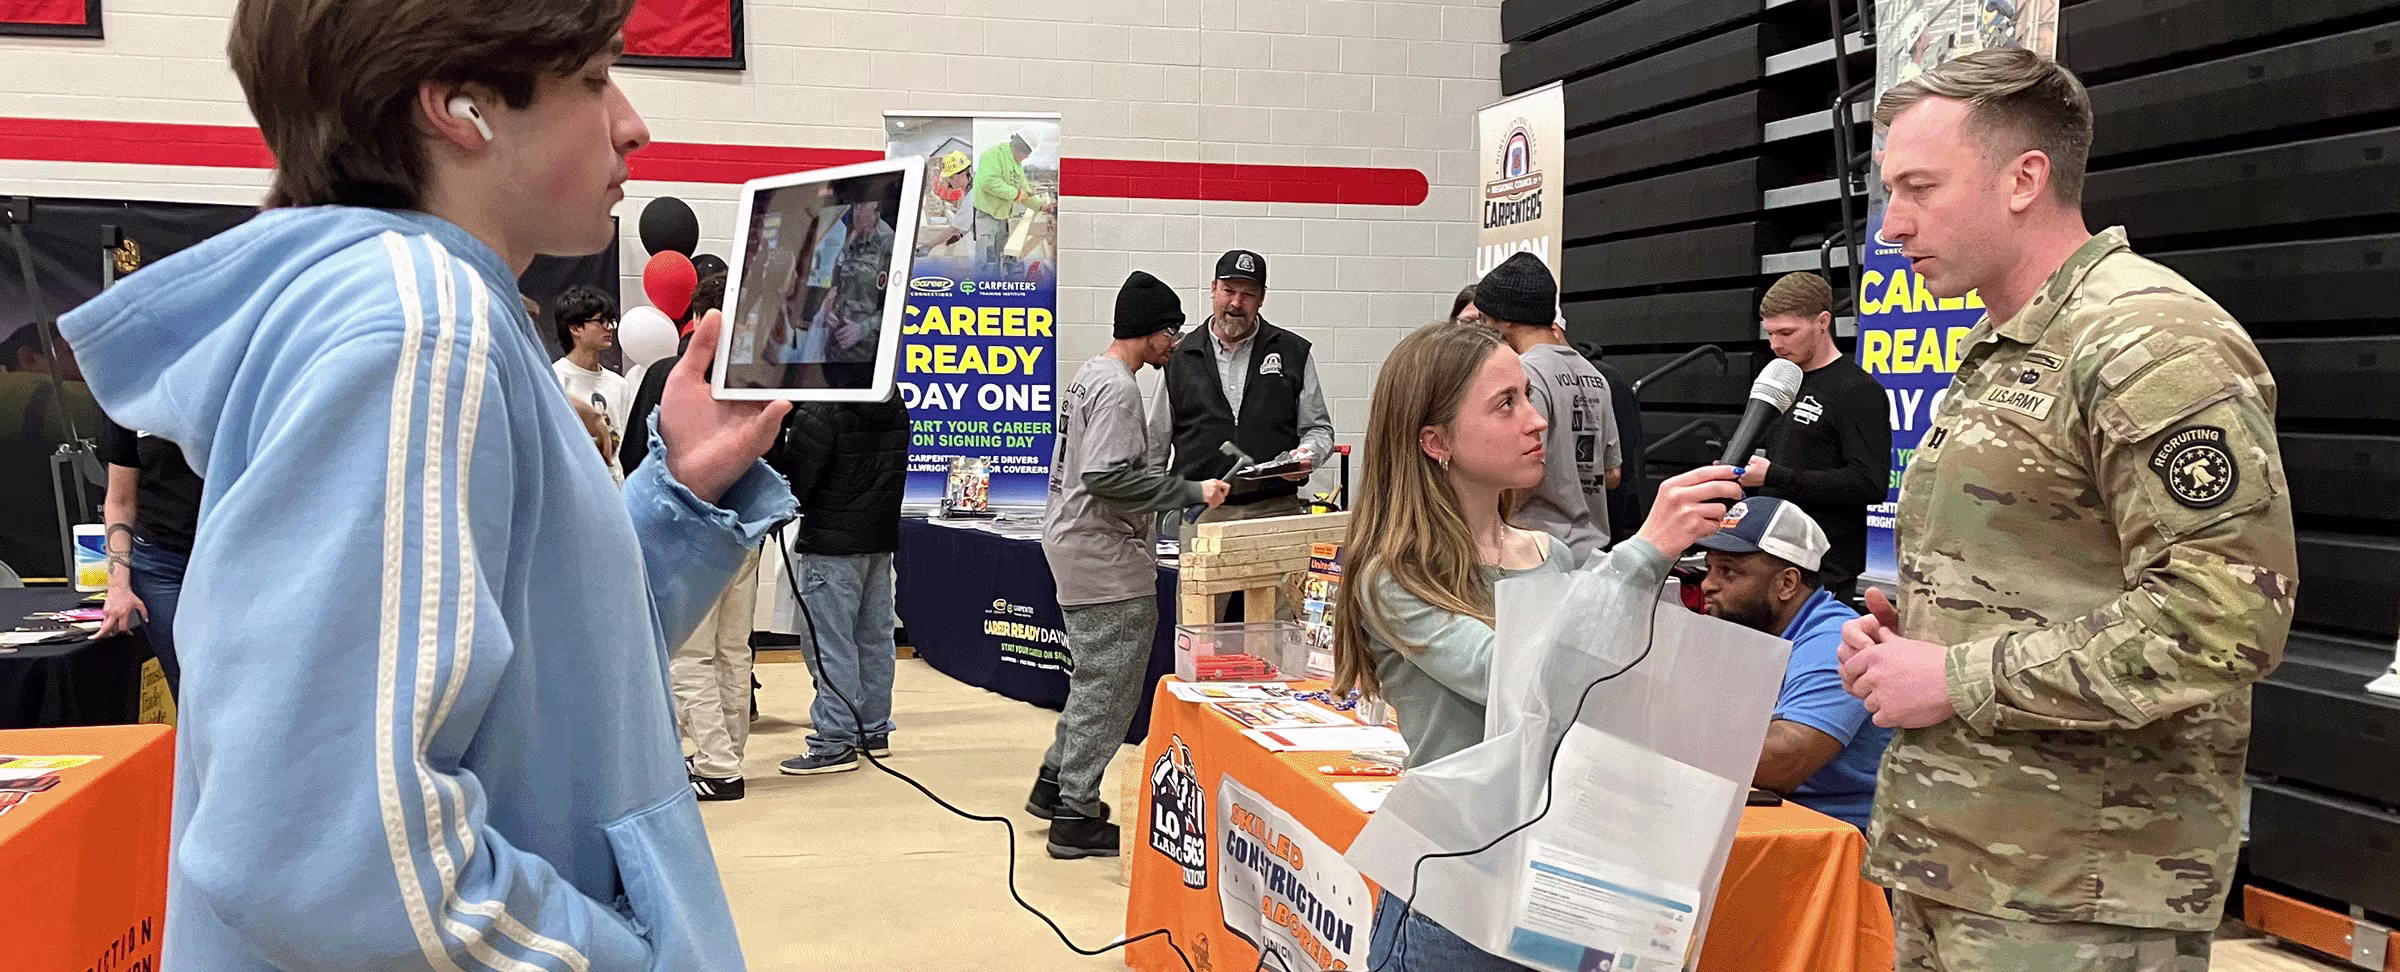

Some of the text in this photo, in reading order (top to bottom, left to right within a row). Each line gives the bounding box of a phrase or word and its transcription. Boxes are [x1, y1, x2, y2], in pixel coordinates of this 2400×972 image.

[1483, 189, 1543, 229] CARPENTERS
[979, 281, 1036, 291] CARPENTERS
[903, 304, 1053, 337] CAREER
[906, 344, 1043, 375] READY
[896, 382, 969, 411] DAY
[977, 383, 1051, 411] ONE
[912, 434, 1035, 448] ON SIGNING DAY
[947, 420, 989, 433] YOUR
[992, 422, 1052, 434] CAREER
[1000, 456, 1039, 464] DRIVERS
[2154, 428, 2220, 468] RECRUITING
[1002, 466, 1049, 474] COVERERS
[1011, 622, 1041, 642] READY
[1230, 803, 1304, 871] SKILLED
[1226, 829, 1354, 956] CONSTRUCTION
[1262, 895, 1349, 972] ABORERS
[1262, 935, 1294, 964] UNION
